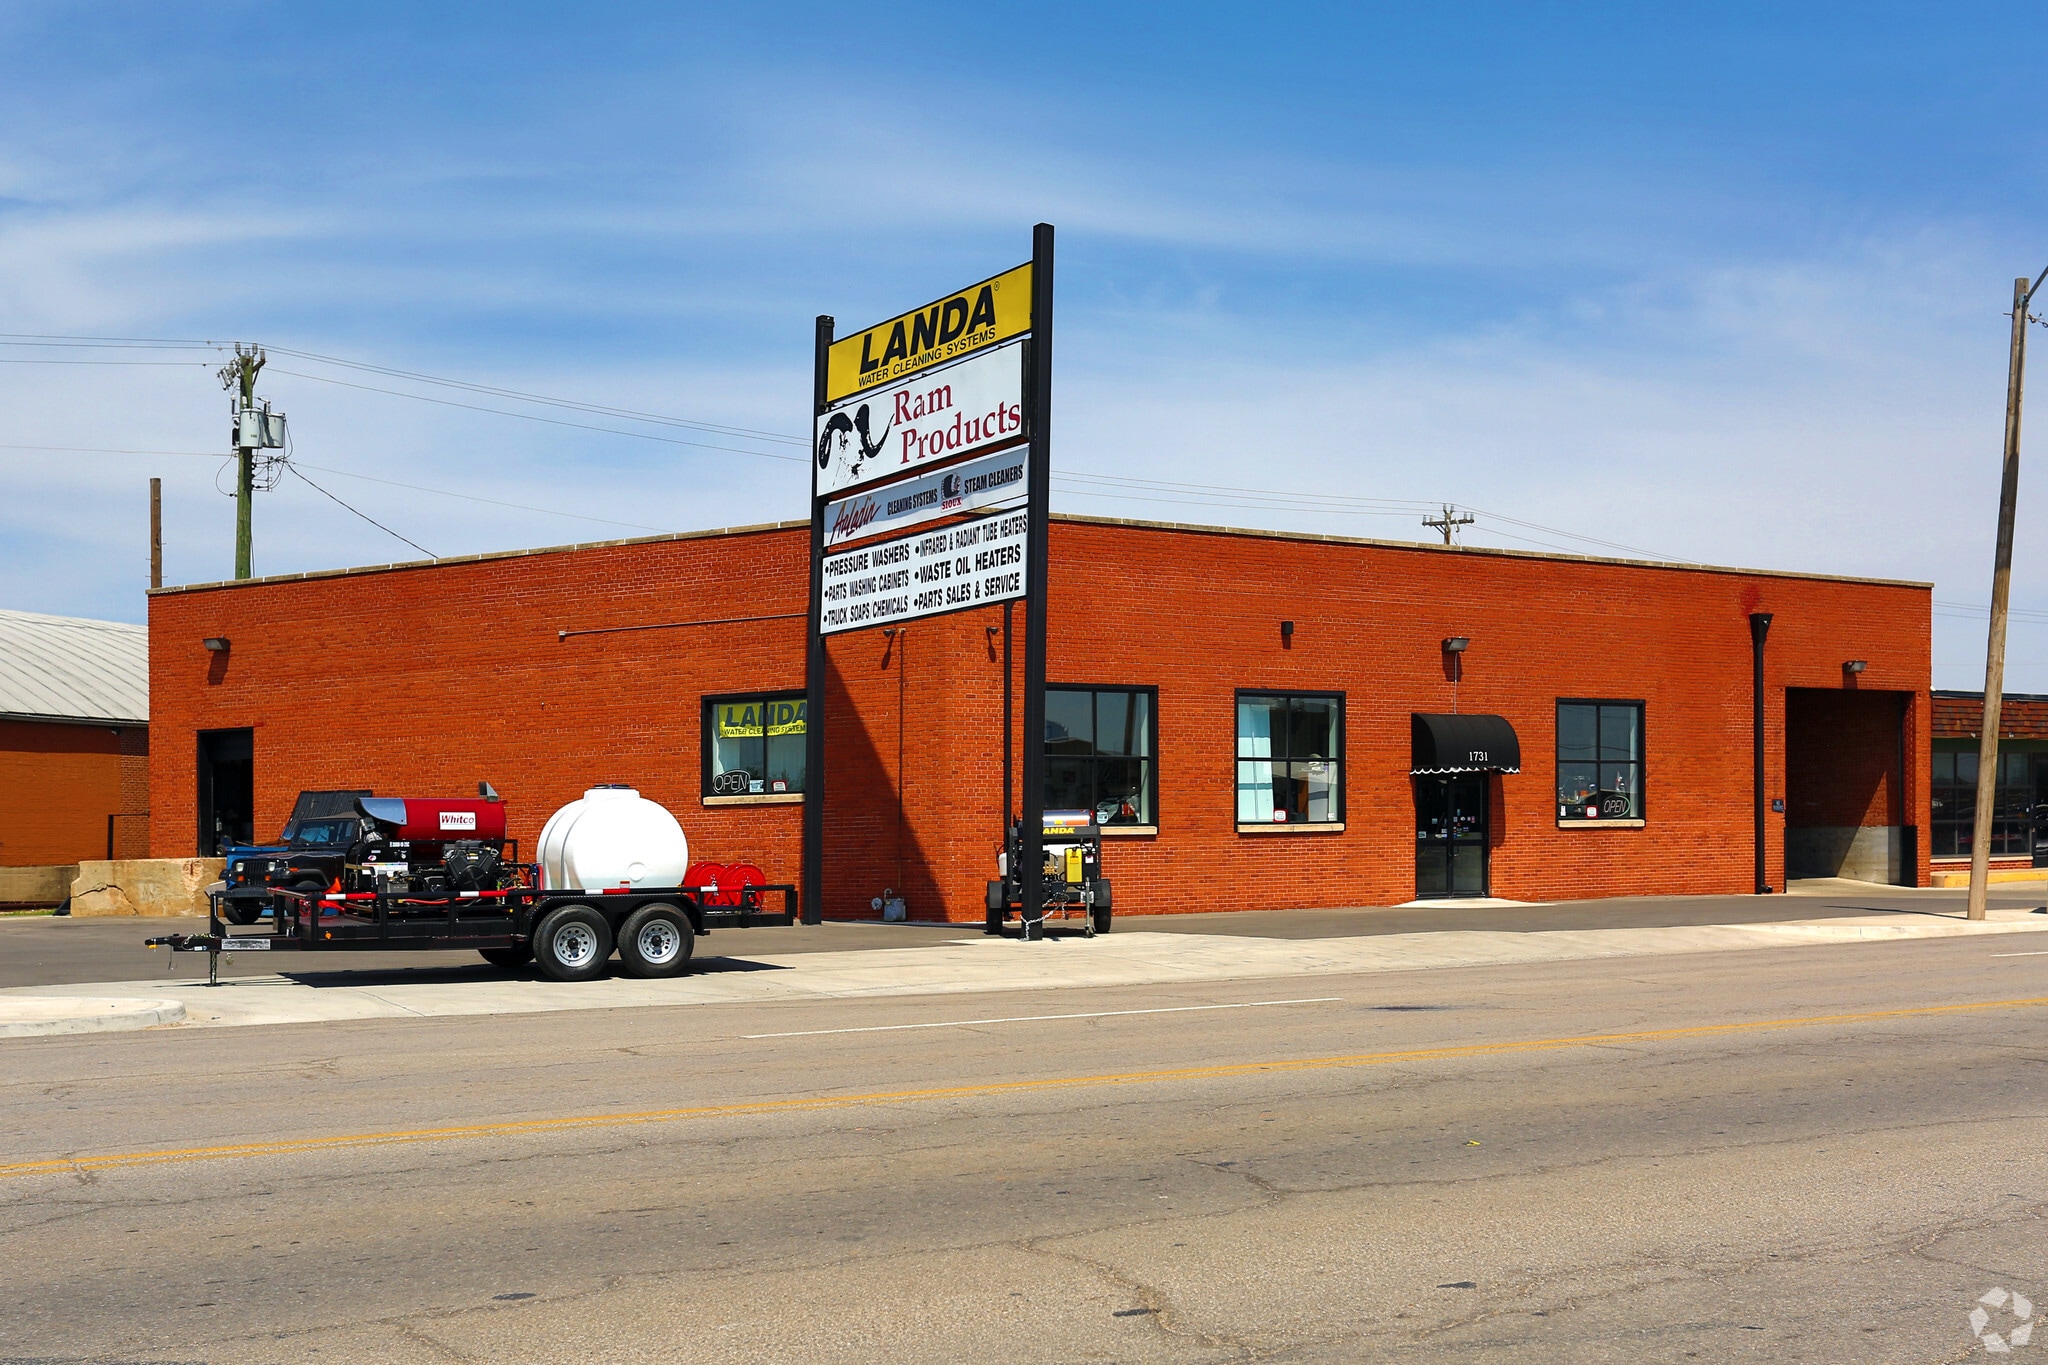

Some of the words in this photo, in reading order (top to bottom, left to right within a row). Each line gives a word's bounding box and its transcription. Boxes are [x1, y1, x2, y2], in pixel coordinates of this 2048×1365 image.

[859, 284, 996, 375] LANDA
[859, 368, 888, 387] WATER
[893, 348, 942, 375] CLEANING
[946, 327, 996, 355] SYSTEMS
[893, 384, 953, 427] Ram
[900, 401, 1021, 464] Products
[964, 475, 987, 494] STEAM
[988, 464, 1023, 488] CLEANERS
[887, 496, 912, 516] CLEANING
[912, 488, 938, 509] SYSTEMS
[941, 497, 962, 510] SIOUX
[920, 534, 947, 557] INFRARED
[949, 533, 953, 551] &
[955, 526, 980, 549] RADIANT
[982, 521, 998, 543] TUBE
[1000, 514, 1027, 539] HEATERS
[829, 553, 869, 578] PRESSURE
[872, 543, 910, 568] WASHERS
[920, 560, 951, 584] WASTE
[955, 556, 971, 576] OIL
[975, 543, 1021, 572] HEATERS
[828, 582, 847, 602] PARTS
[849, 576, 877, 598] WASHING
[879, 569, 909, 592] CABINETS
[918, 588, 943, 610] PARTS
[946, 582, 971, 605] SALES
[975, 580, 981, 599] &
[984, 572, 1020, 597] SERVICE
[828, 606, 848, 626] TRUCK
[725, 702, 807, 727] LANDA
[781, 724, 806, 734] SYSTEM
[1469, 751, 1488, 761] 1731
[714, 774, 748, 791] OPEN
[441, 814, 475, 824] Whitco
[1603, 800, 1627, 813] OPEN
